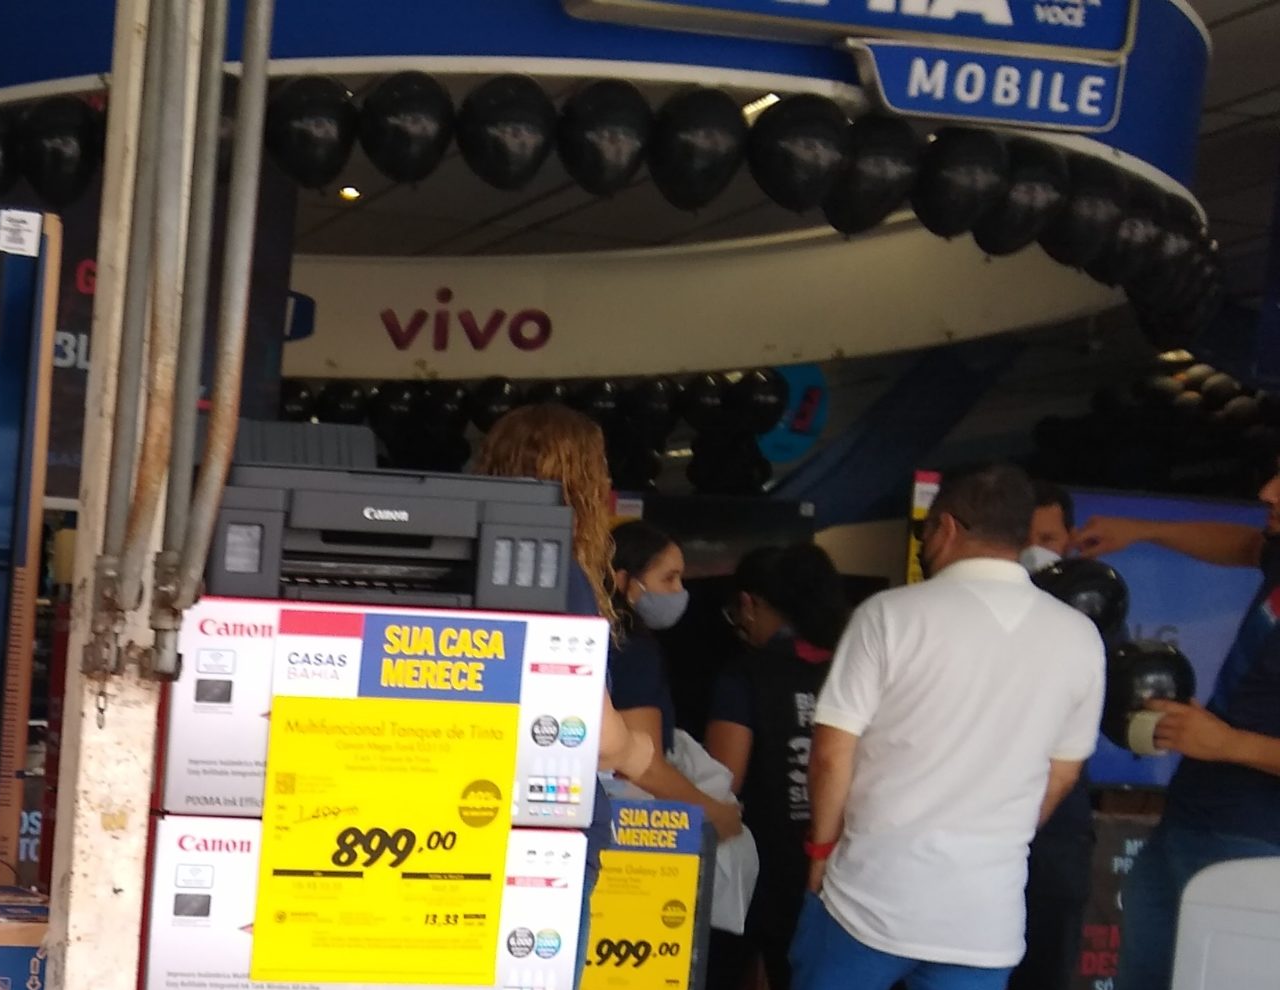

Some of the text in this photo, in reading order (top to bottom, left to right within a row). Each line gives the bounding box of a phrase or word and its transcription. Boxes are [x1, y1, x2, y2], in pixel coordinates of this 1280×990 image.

[907, 57, 1107, 116] MOBILE
[380, 287, 552, 351] vivo
[363, 506, 409, 522] Canon
[198, 618, 273, 640] Canon
[383, 625, 506, 659] SUA CASA
[287, 652, 347, 667] CASAS
[287, 668, 340, 681] BAHIA
[380, 658, 485, 691] MERECE
[284, 720, 504, 742] Multifuncional Tanque de Tinta
[619, 808, 690, 830] SUA CASA
[177, 834, 252, 855] Canon
[617, 828, 678, 848] MERECE
